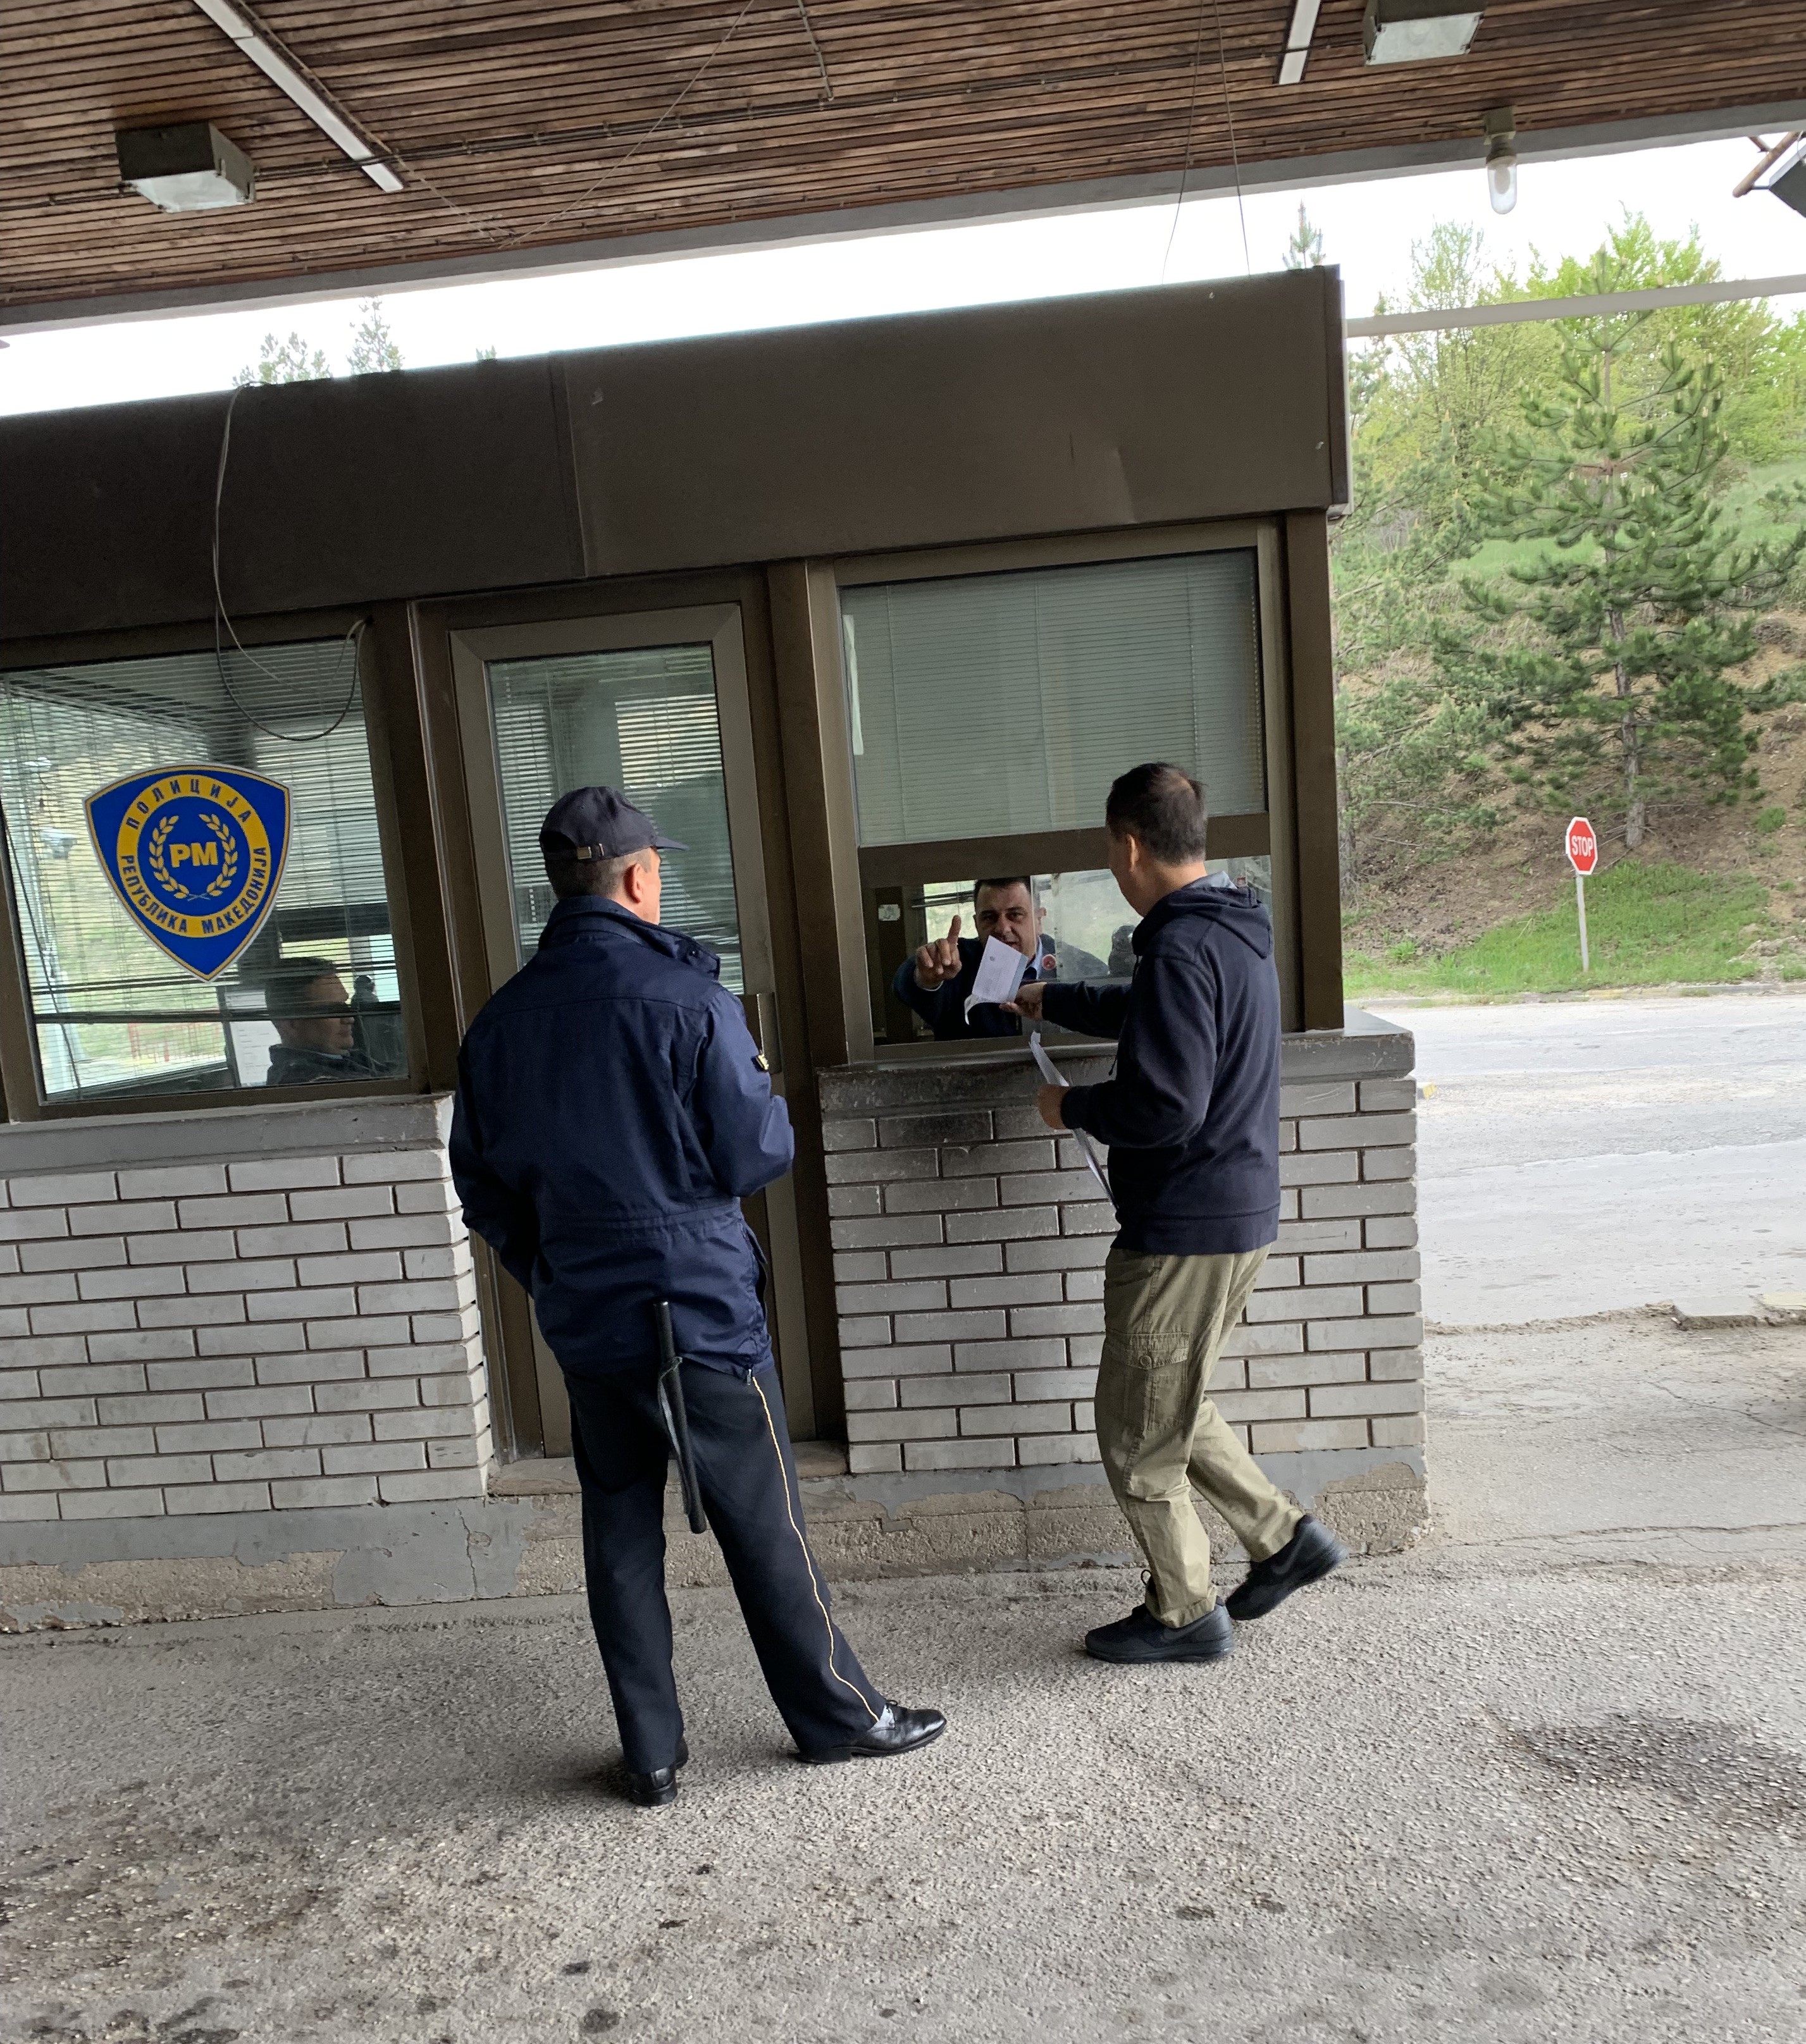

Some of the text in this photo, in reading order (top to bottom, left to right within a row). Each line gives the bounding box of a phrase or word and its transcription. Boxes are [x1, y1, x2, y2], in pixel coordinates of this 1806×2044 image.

[126, 779, 251, 829] ПОЛИЦИЈА
[1571, 835, 1593, 857] STOP
[121, 847, 267, 934] РЕПУБЛИКА МАКЕДОНИЈА
